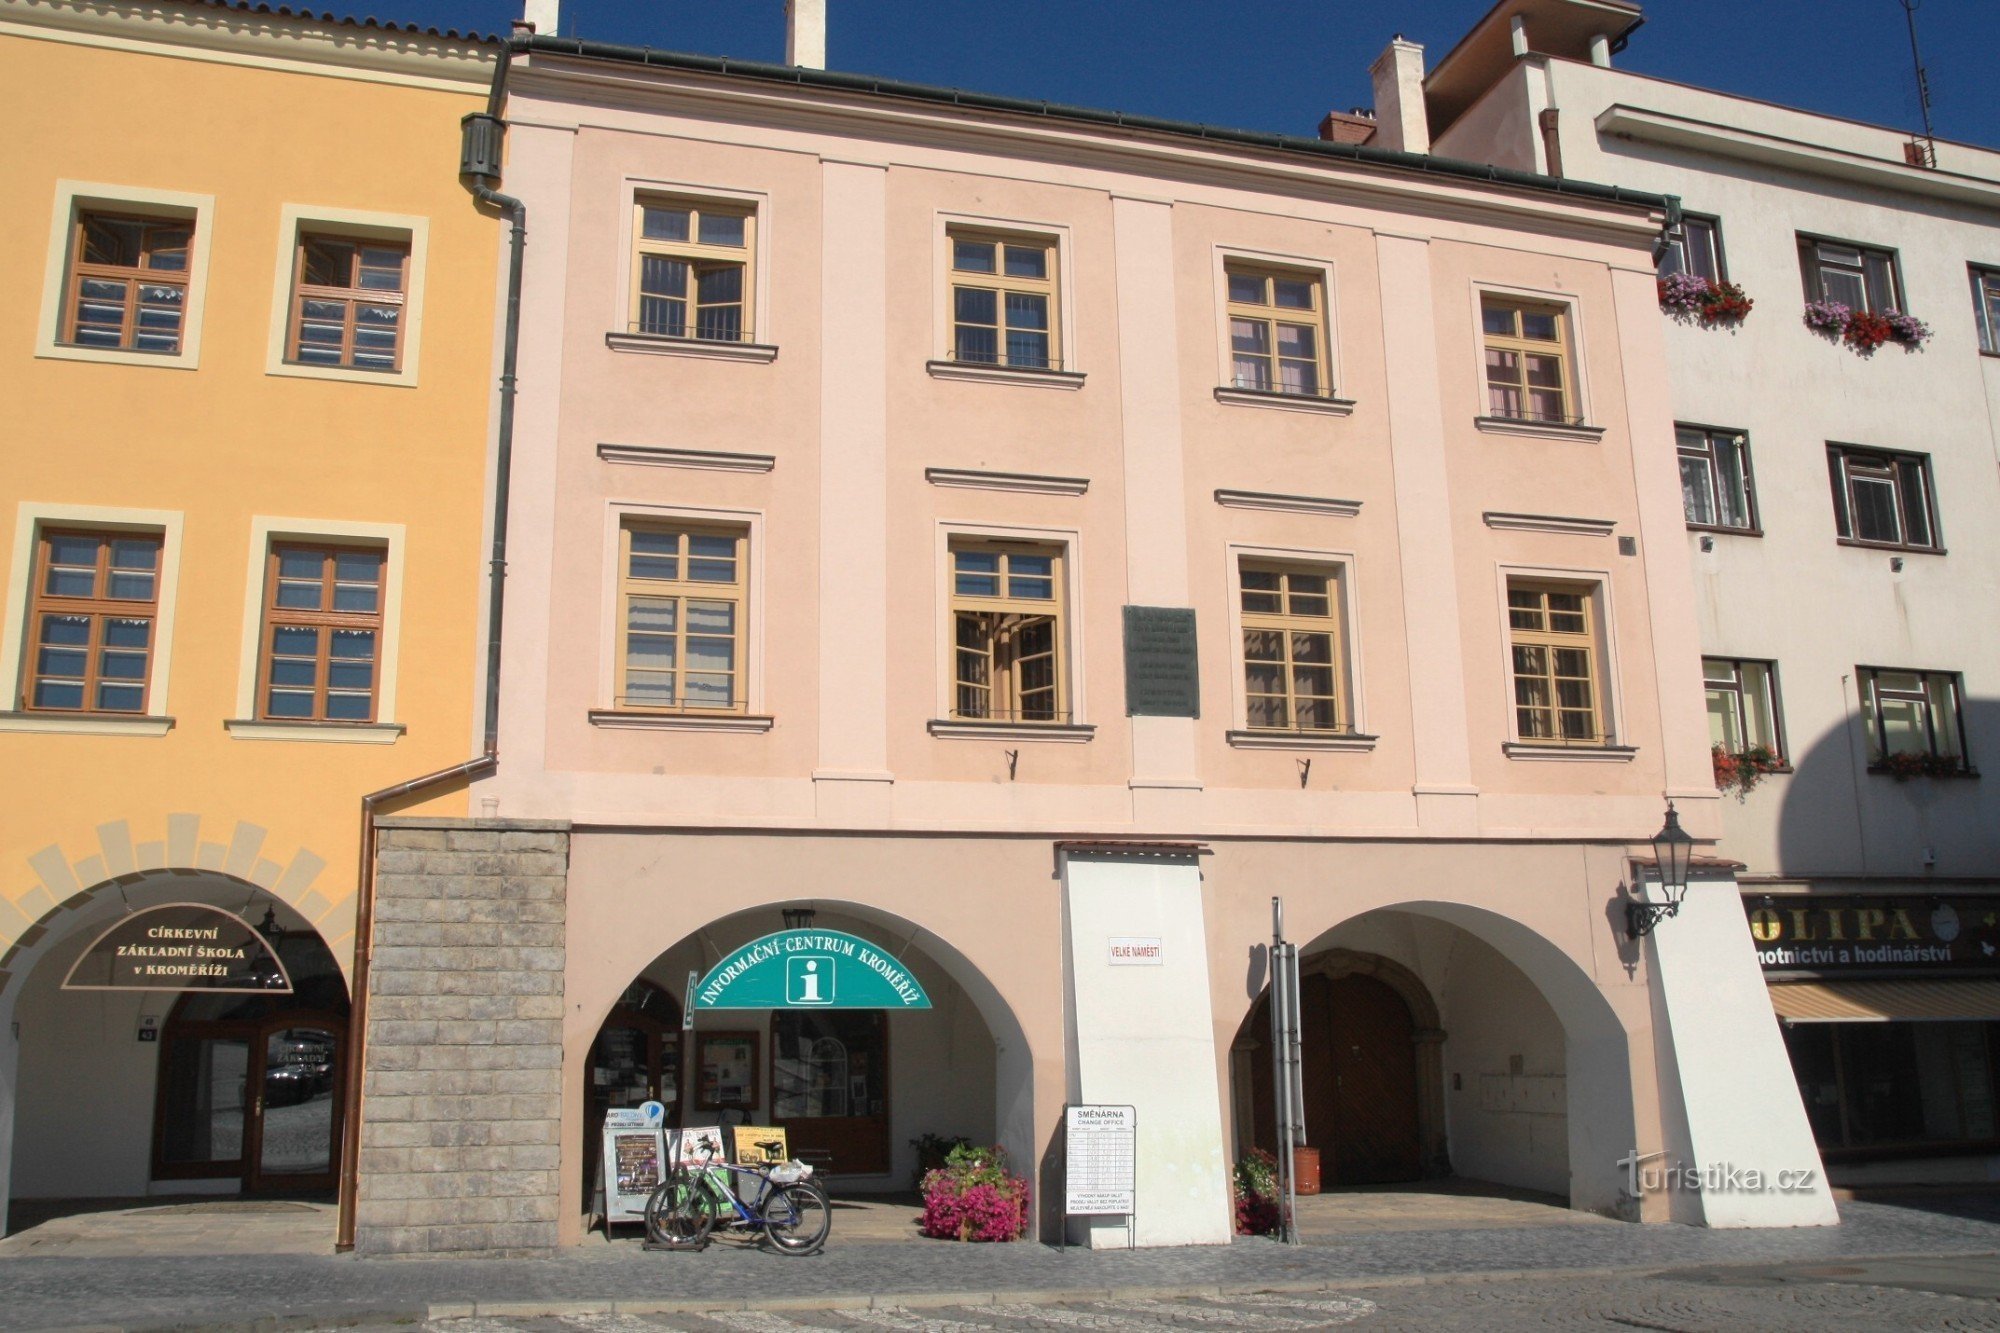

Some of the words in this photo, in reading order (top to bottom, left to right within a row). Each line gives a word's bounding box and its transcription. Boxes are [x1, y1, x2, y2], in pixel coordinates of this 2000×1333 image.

[1751, 909, 1921, 941] OLIPA
[148, 926, 219, 940] CÍRKEVNÍ
[116, 945, 193, 958] ZÁKLADNÍ
[196, 946, 245, 959] ŠKOLA
[1111, 944, 1131, 957] VELKÉ
[1839, 951, 1850, 963] a
[1855, 944, 1952, 963] hodinářství
[134, 966, 143, 975] v
[146, 963, 228, 976] KROMĚŘÍŽI
[700, 938, 781, 1006] INFORMAČNÍ
[785, 936, 856, 957] CENTRUM
[858, 947, 921, 1006] KROMĚŘÍŽ
[1078, 1109, 1124, 1118] SMĚNÁRNA
